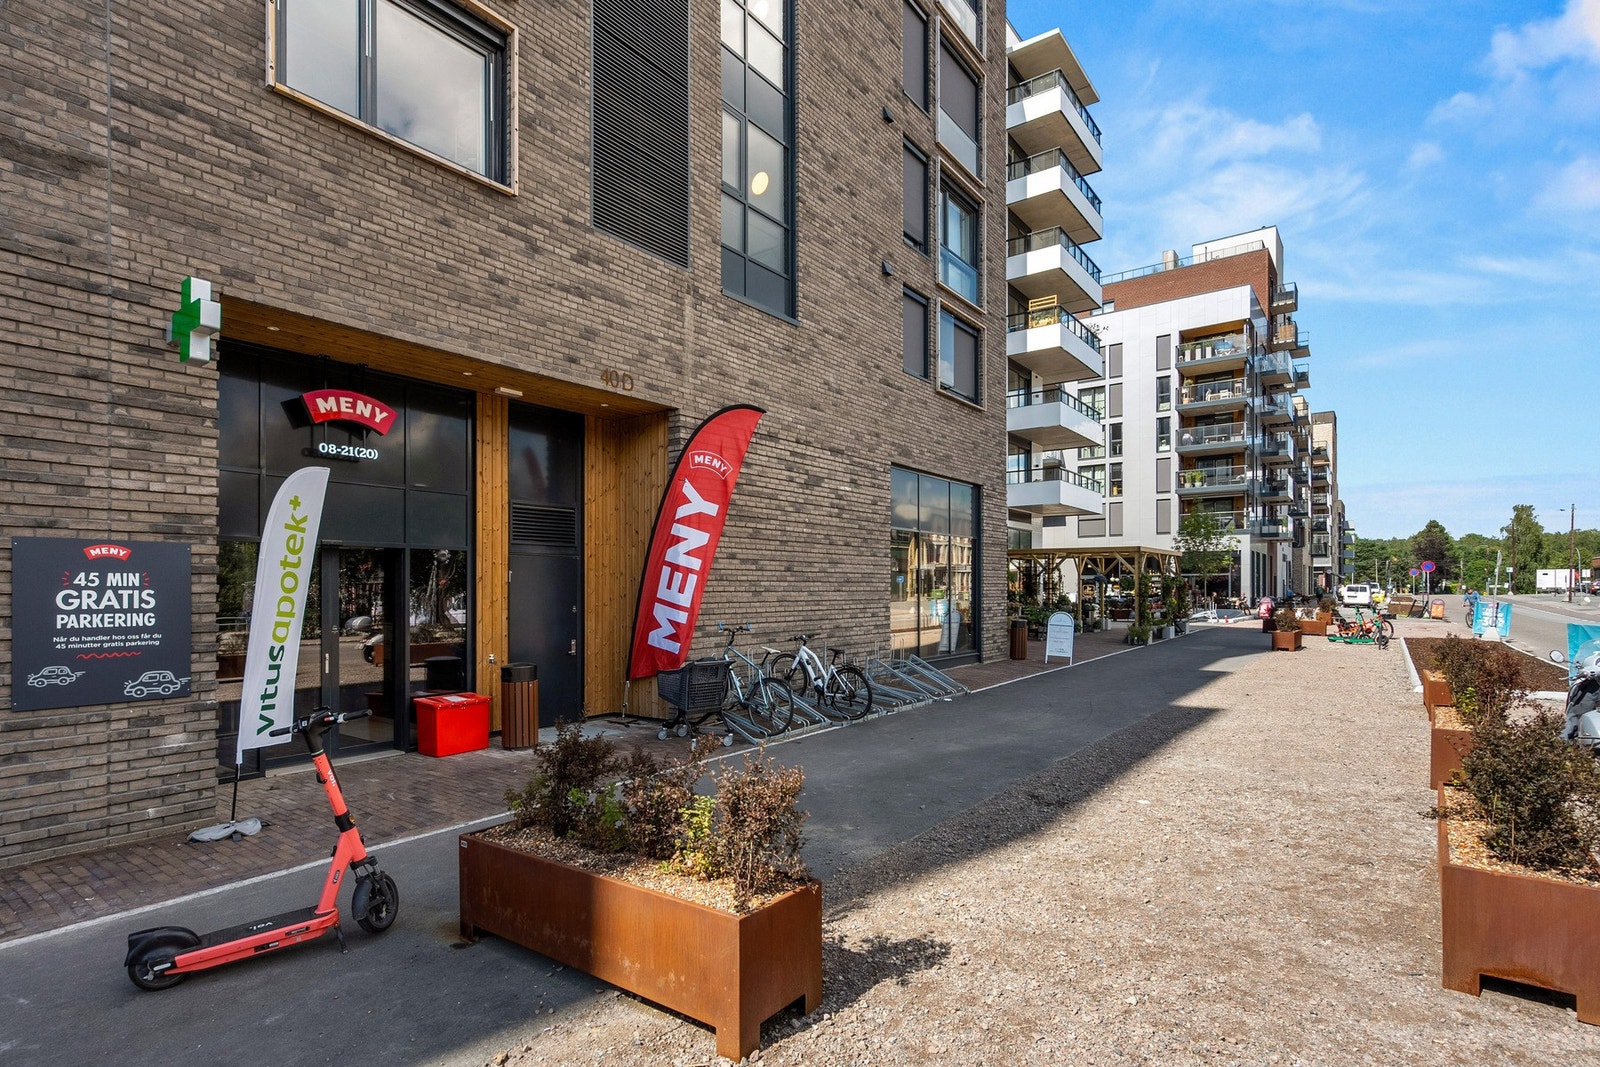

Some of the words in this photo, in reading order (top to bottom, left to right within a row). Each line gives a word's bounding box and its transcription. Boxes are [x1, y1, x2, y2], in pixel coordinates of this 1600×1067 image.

[315, 396, 389, 424] MENY
[318, 442, 379, 460] 08-21(20)
[694, 454, 727, 472] MENY
[89, 547, 128, 557] MENY
[647, 477, 720, 655] MENY
[73, 572, 100, 587] 45
[106, 572, 140, 587] MIN
[55, 589, 156, 611] GRATIS
[56, 612, 156, 629] PARKERING
[81, 633, 110, 641] handler
[125, 639, 160, 648] parkering
